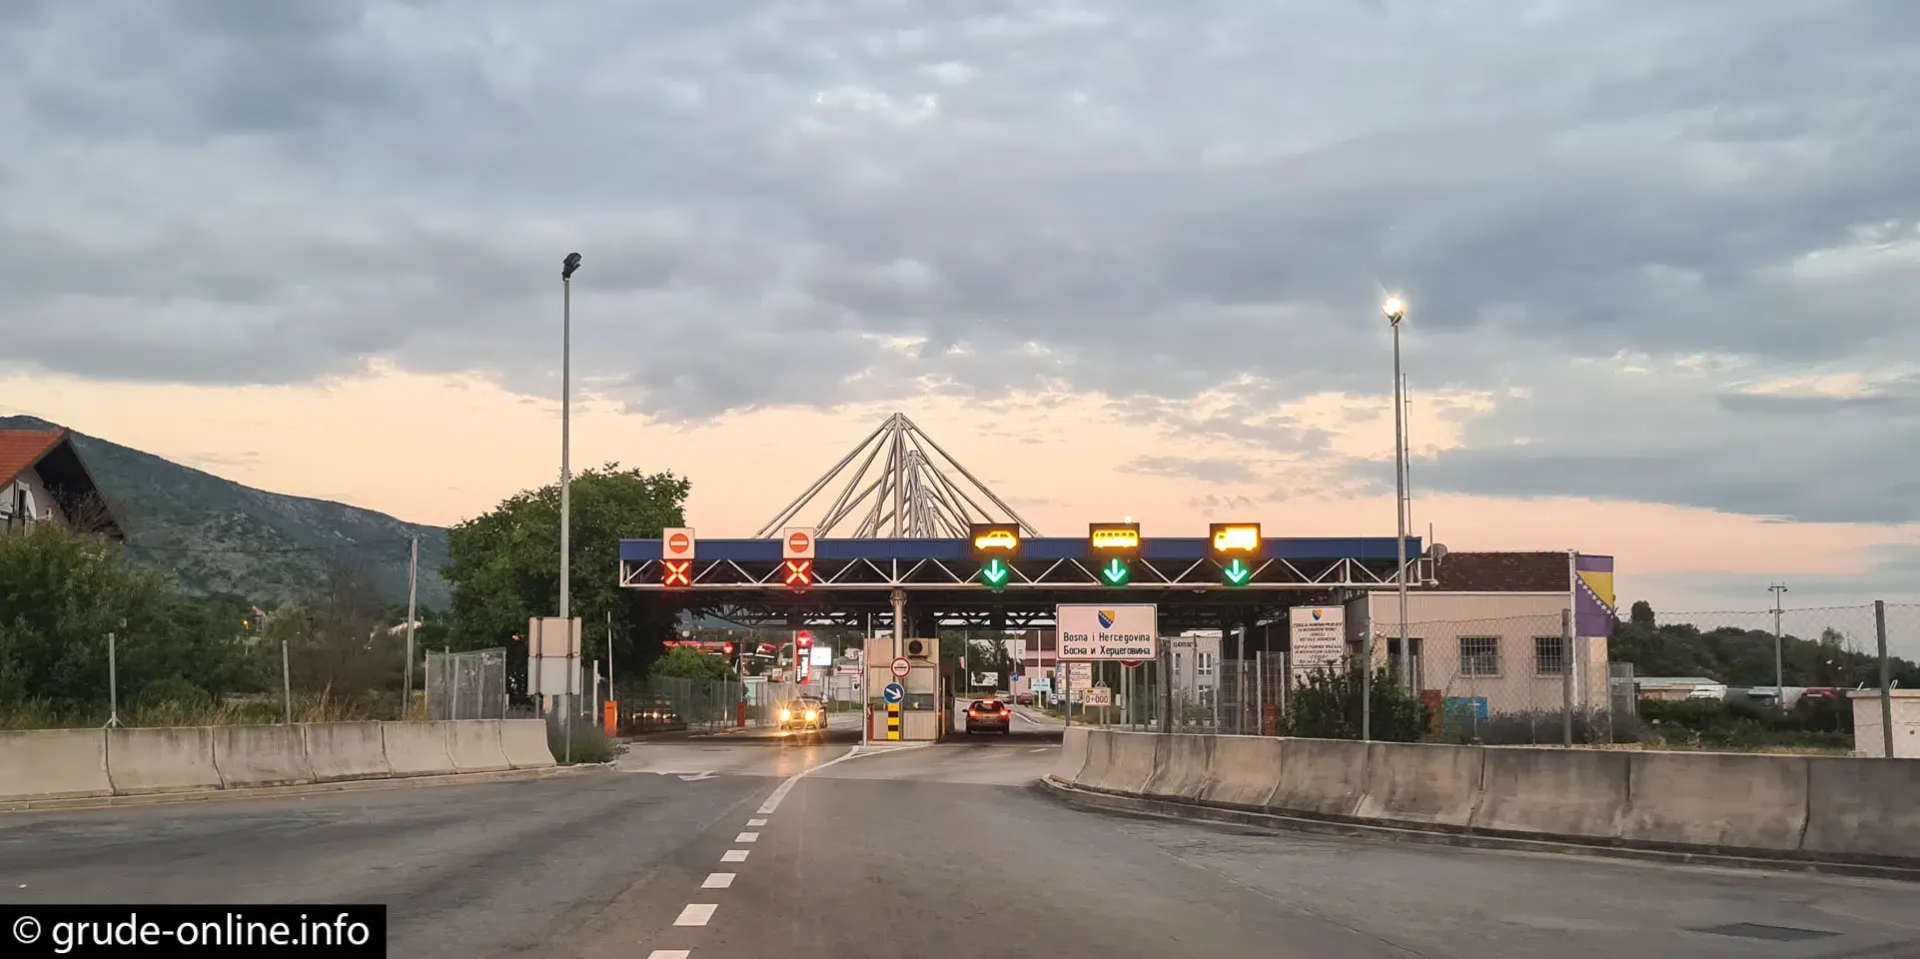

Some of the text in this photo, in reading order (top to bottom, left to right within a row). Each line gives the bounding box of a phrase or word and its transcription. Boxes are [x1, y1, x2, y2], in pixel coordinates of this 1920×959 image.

[1063, 632, 1088, 642] Bosna
[1099, 632, 1150, 644] Hercegovina
[1063, 645, 1150, 657] Босна и Херцеговина
